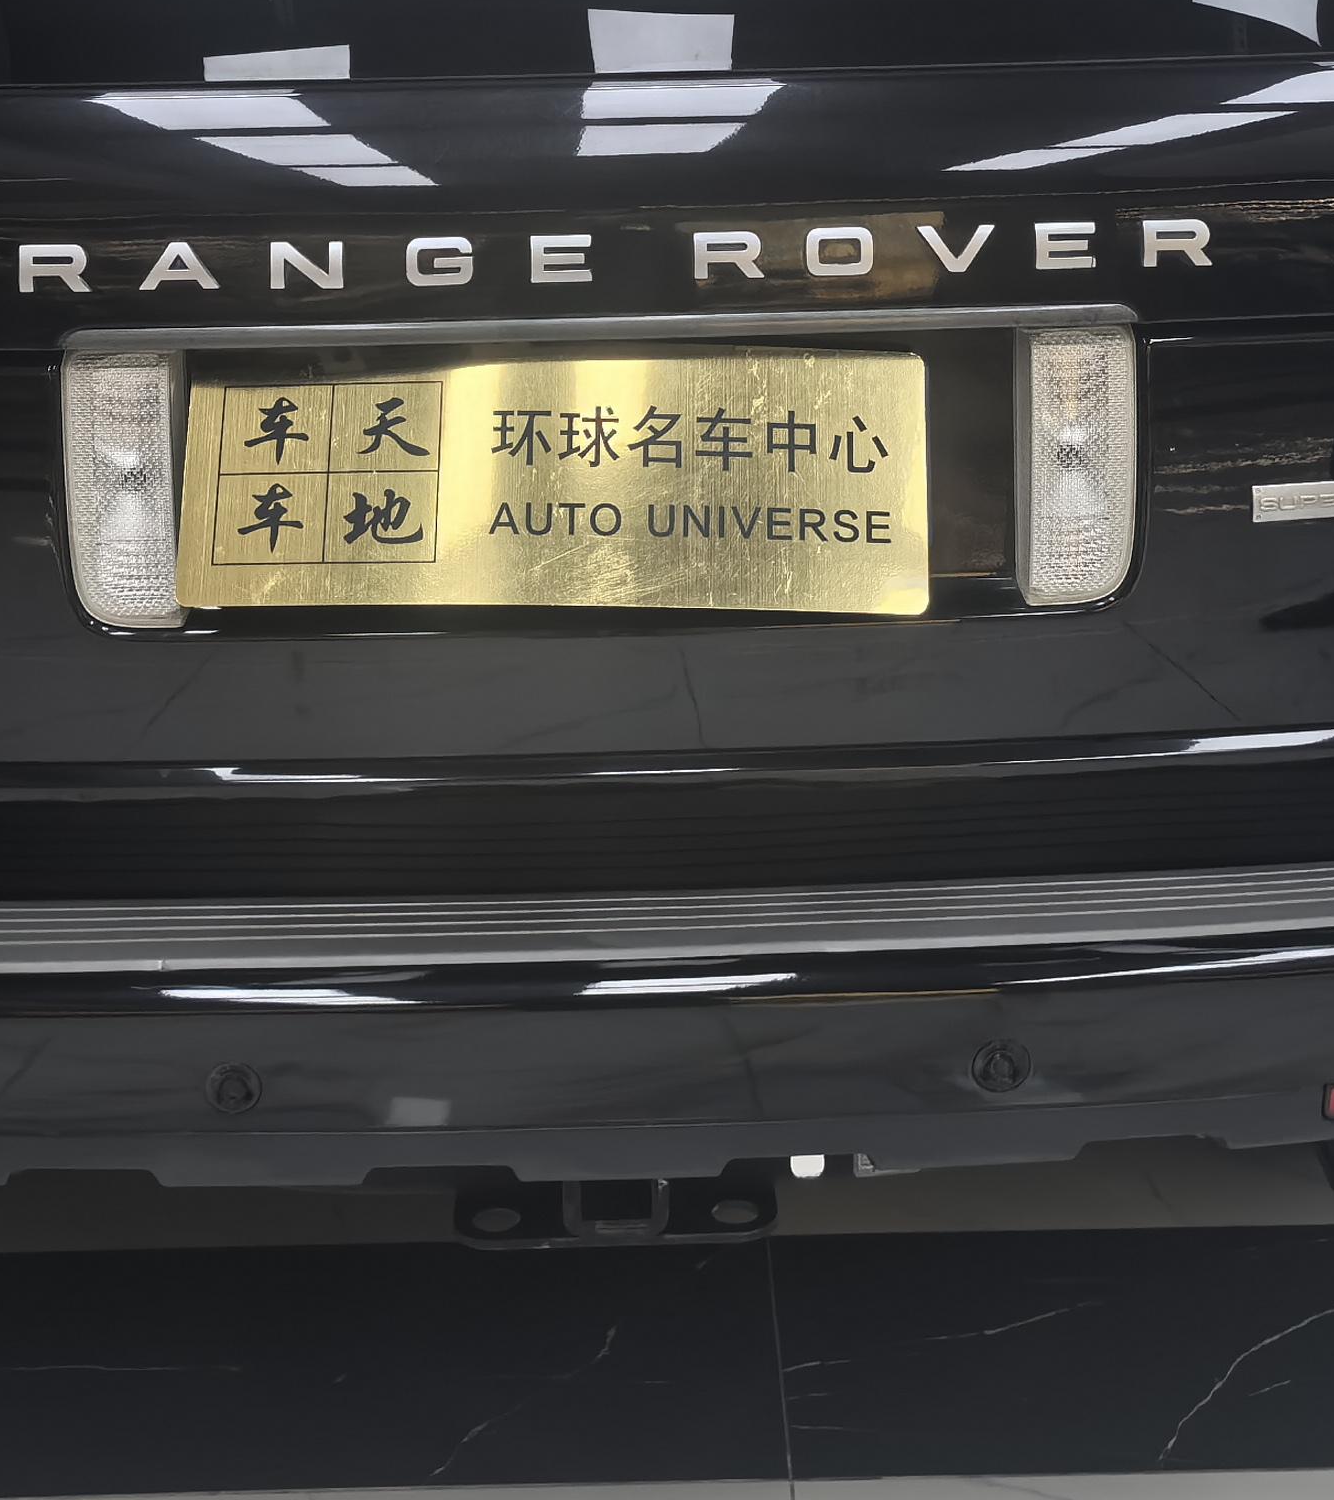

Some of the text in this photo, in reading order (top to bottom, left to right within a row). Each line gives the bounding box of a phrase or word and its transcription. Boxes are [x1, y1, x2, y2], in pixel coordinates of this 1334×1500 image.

[17, 217, 1215, 294] RANGE ROVER
[490, 403, 891, 475] 环球名车中心
[489, 500, 893, 545] AUTO UNIVERSE
